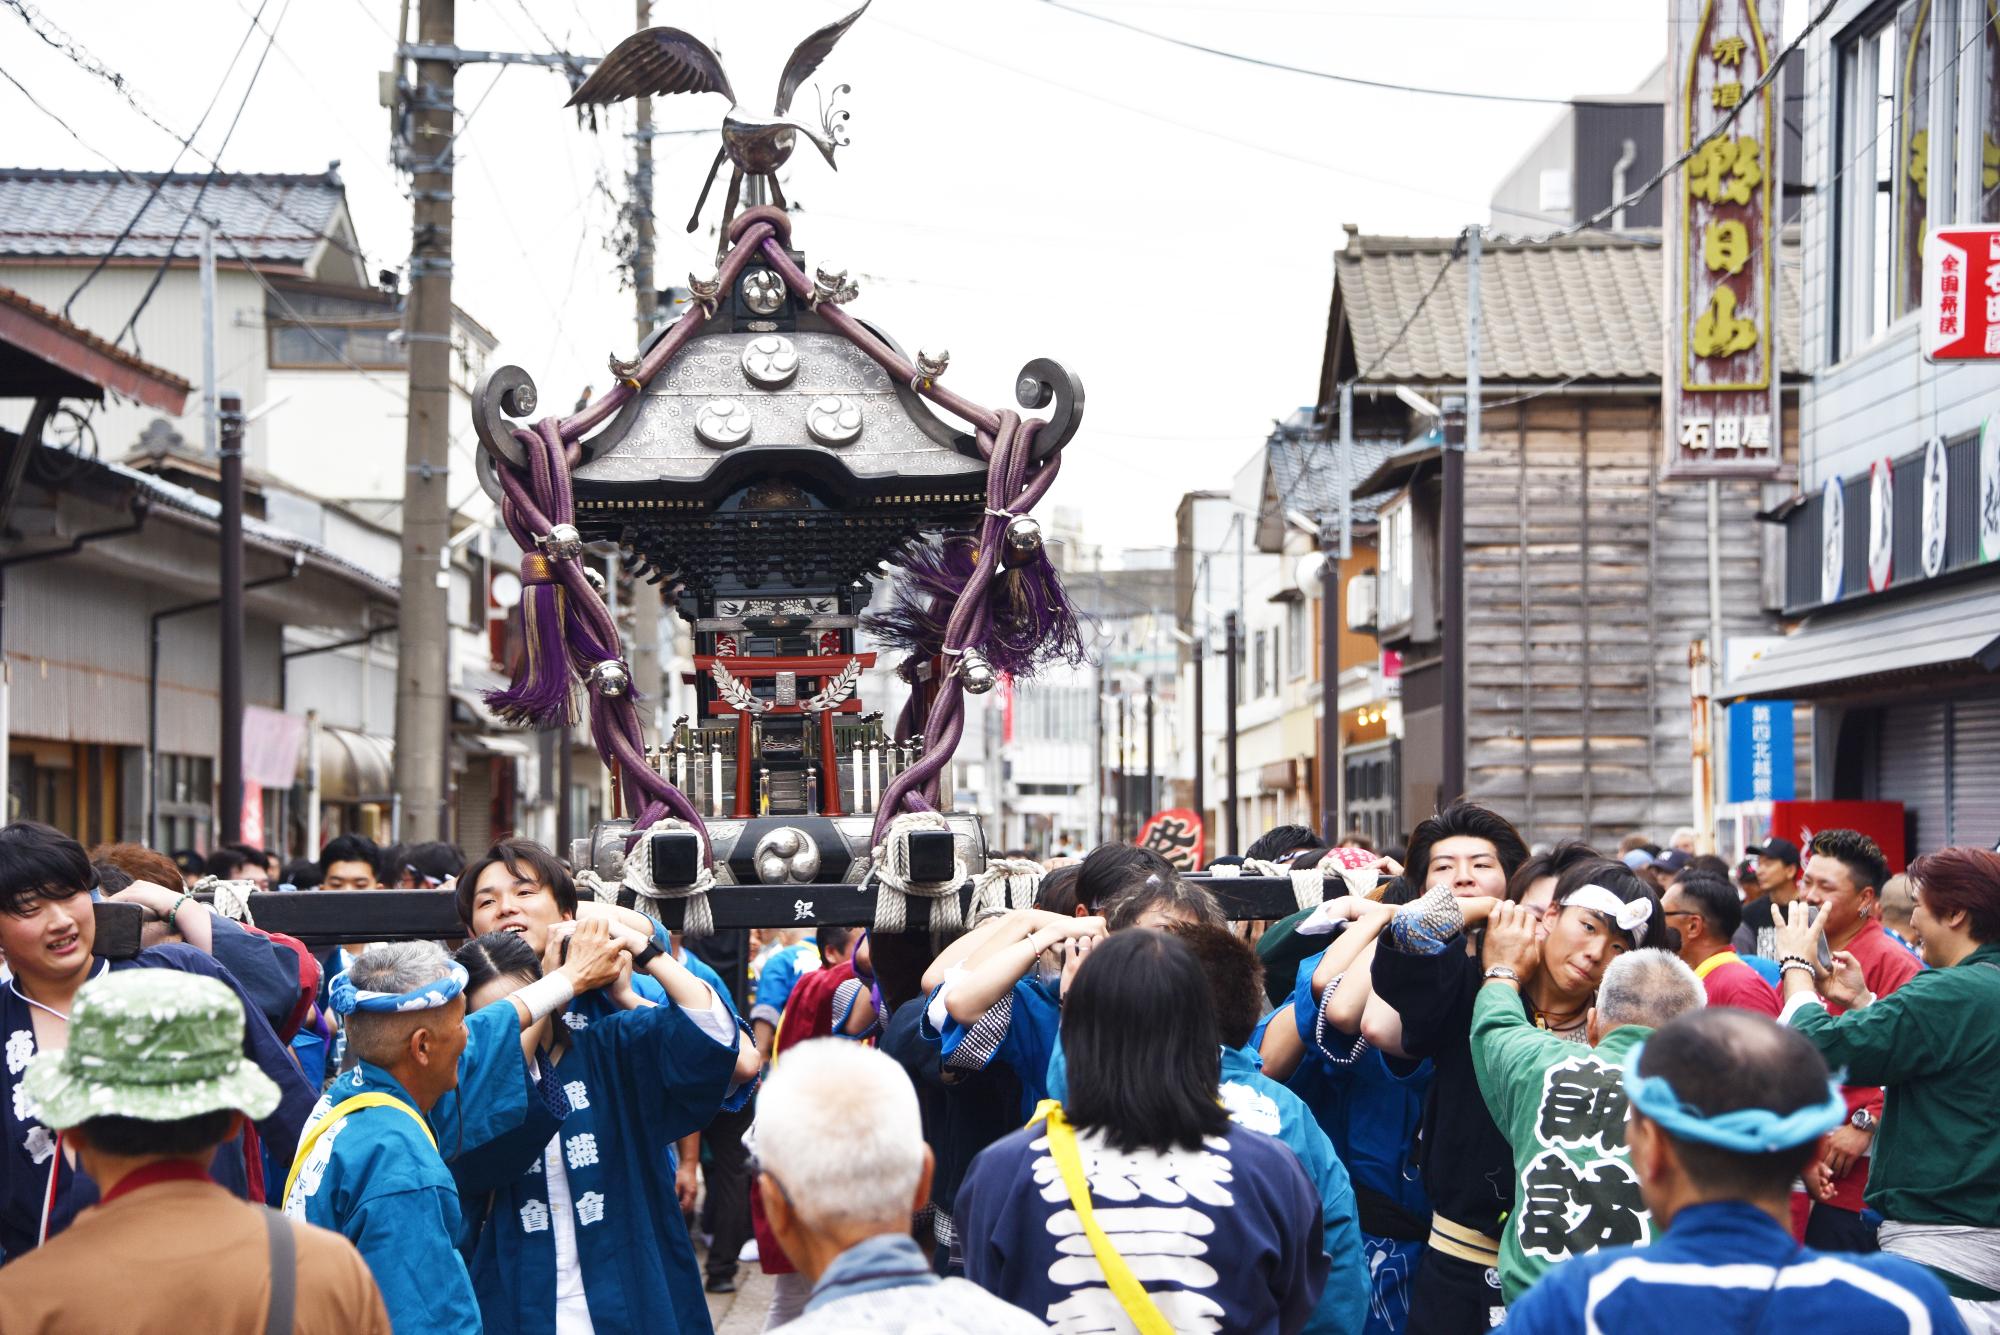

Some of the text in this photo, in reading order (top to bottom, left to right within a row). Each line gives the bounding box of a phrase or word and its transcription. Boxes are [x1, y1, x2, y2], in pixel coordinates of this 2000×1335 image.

[1680, 415, 1769, 449] 石田屋
[794, 899, 816, 921] 銀
